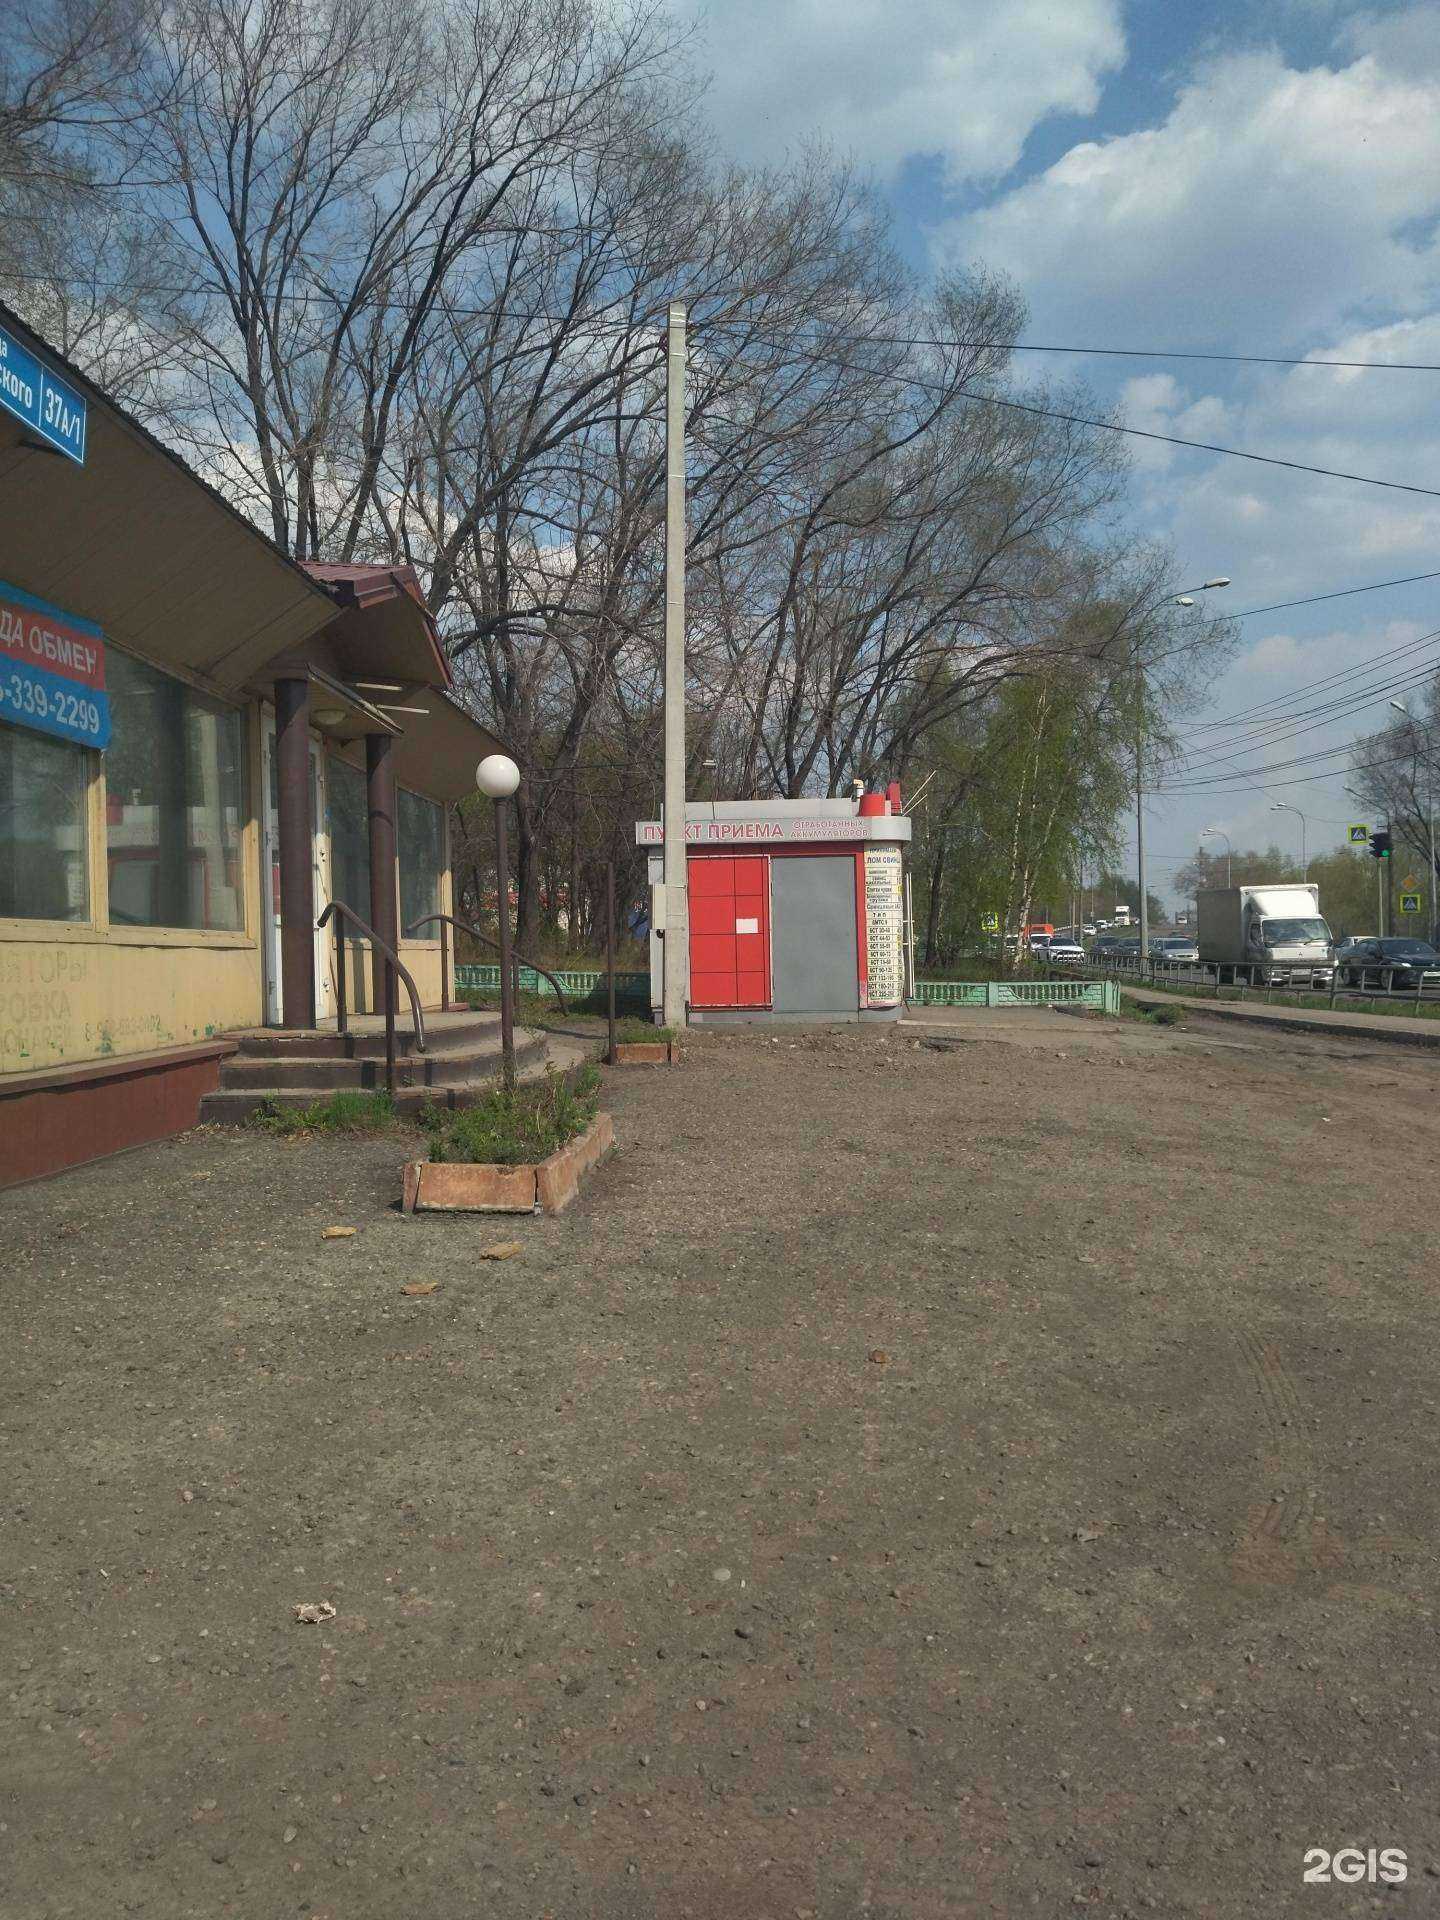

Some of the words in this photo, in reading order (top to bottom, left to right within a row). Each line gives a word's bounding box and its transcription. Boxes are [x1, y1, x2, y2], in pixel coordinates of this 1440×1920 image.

[45, 388, 81, 445] 37А/1
[29, 625, 98, 675] ОБМЕН
[0, 675, 101, 735] -339-2299
[643, 823, 703, 840] ПУКТ
[708, 822, 785, 839] ПРИЕМА
[867, 856, 882, 864] ЛОМ
